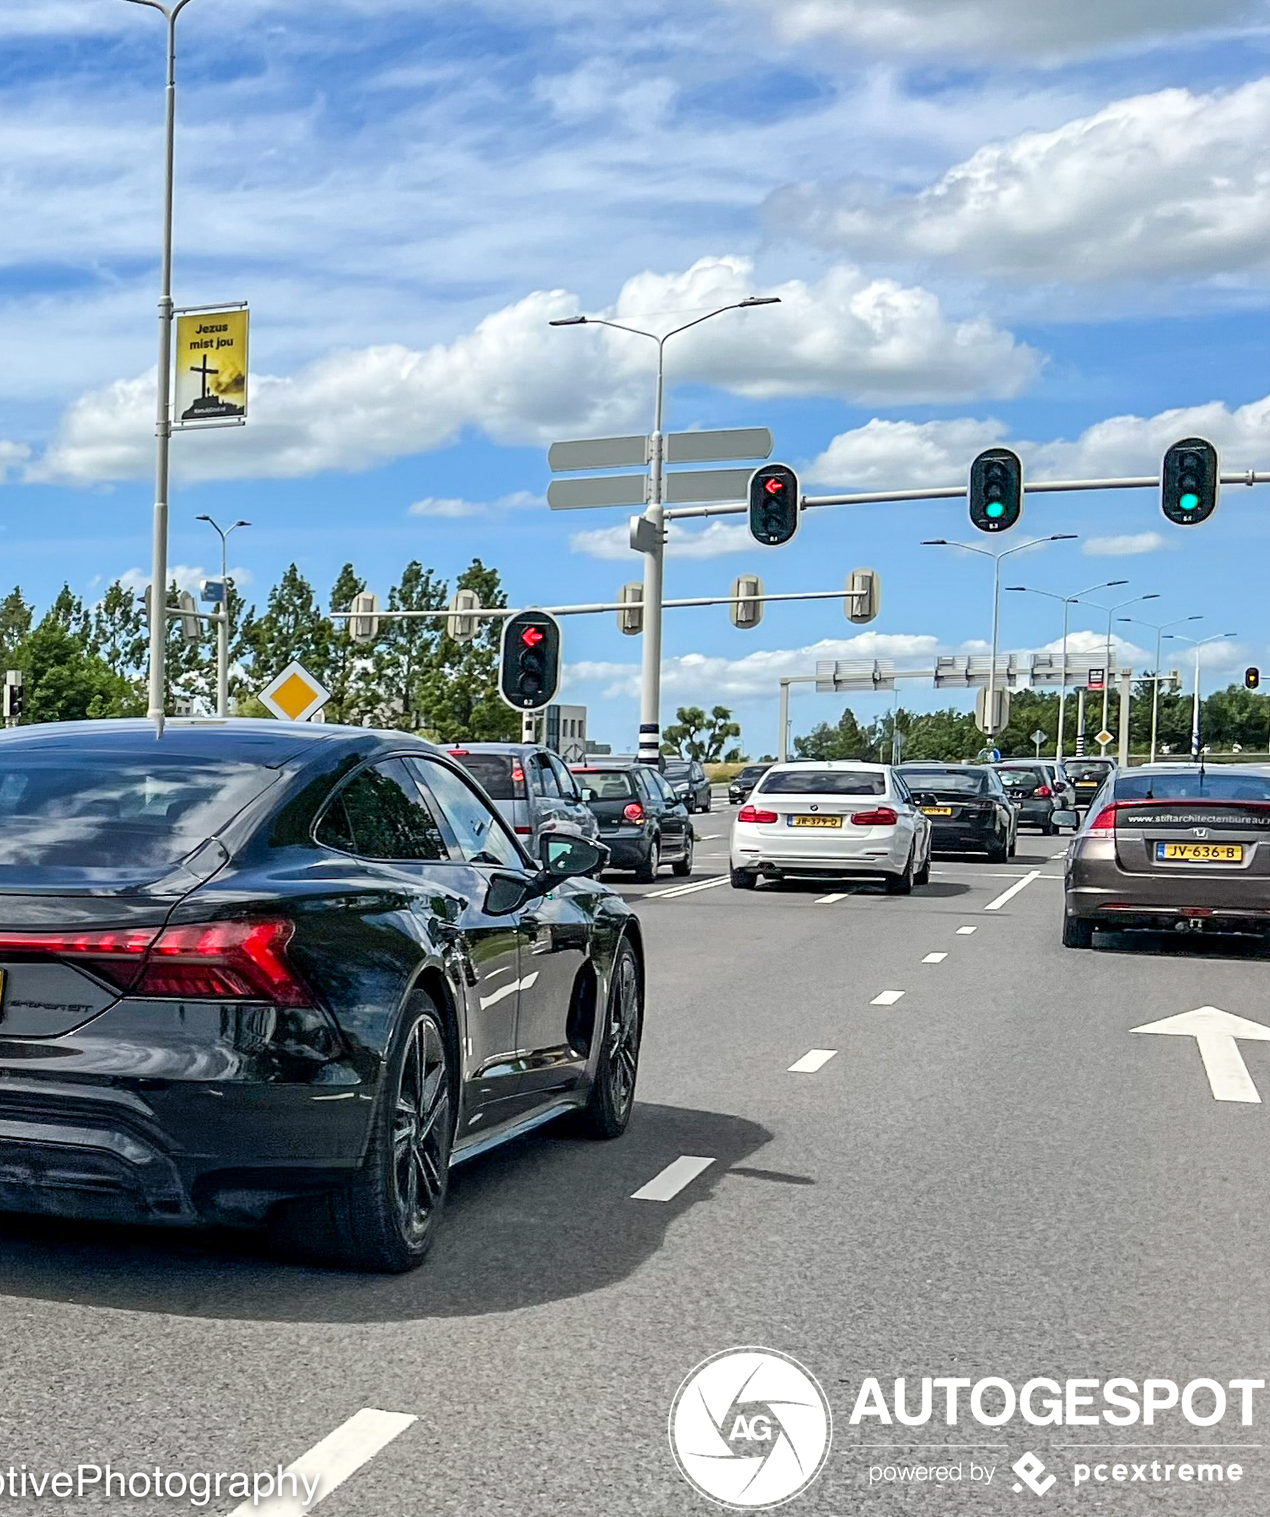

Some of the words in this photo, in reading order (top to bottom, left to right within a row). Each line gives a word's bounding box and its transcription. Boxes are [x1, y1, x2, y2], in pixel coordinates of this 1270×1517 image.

[195, 324, 228, 334] Jezus
[190, 338, 213, 350] mist
[215, 337, 234, 350] jou
[1170, 846, 1235, 858] JV-636-B
